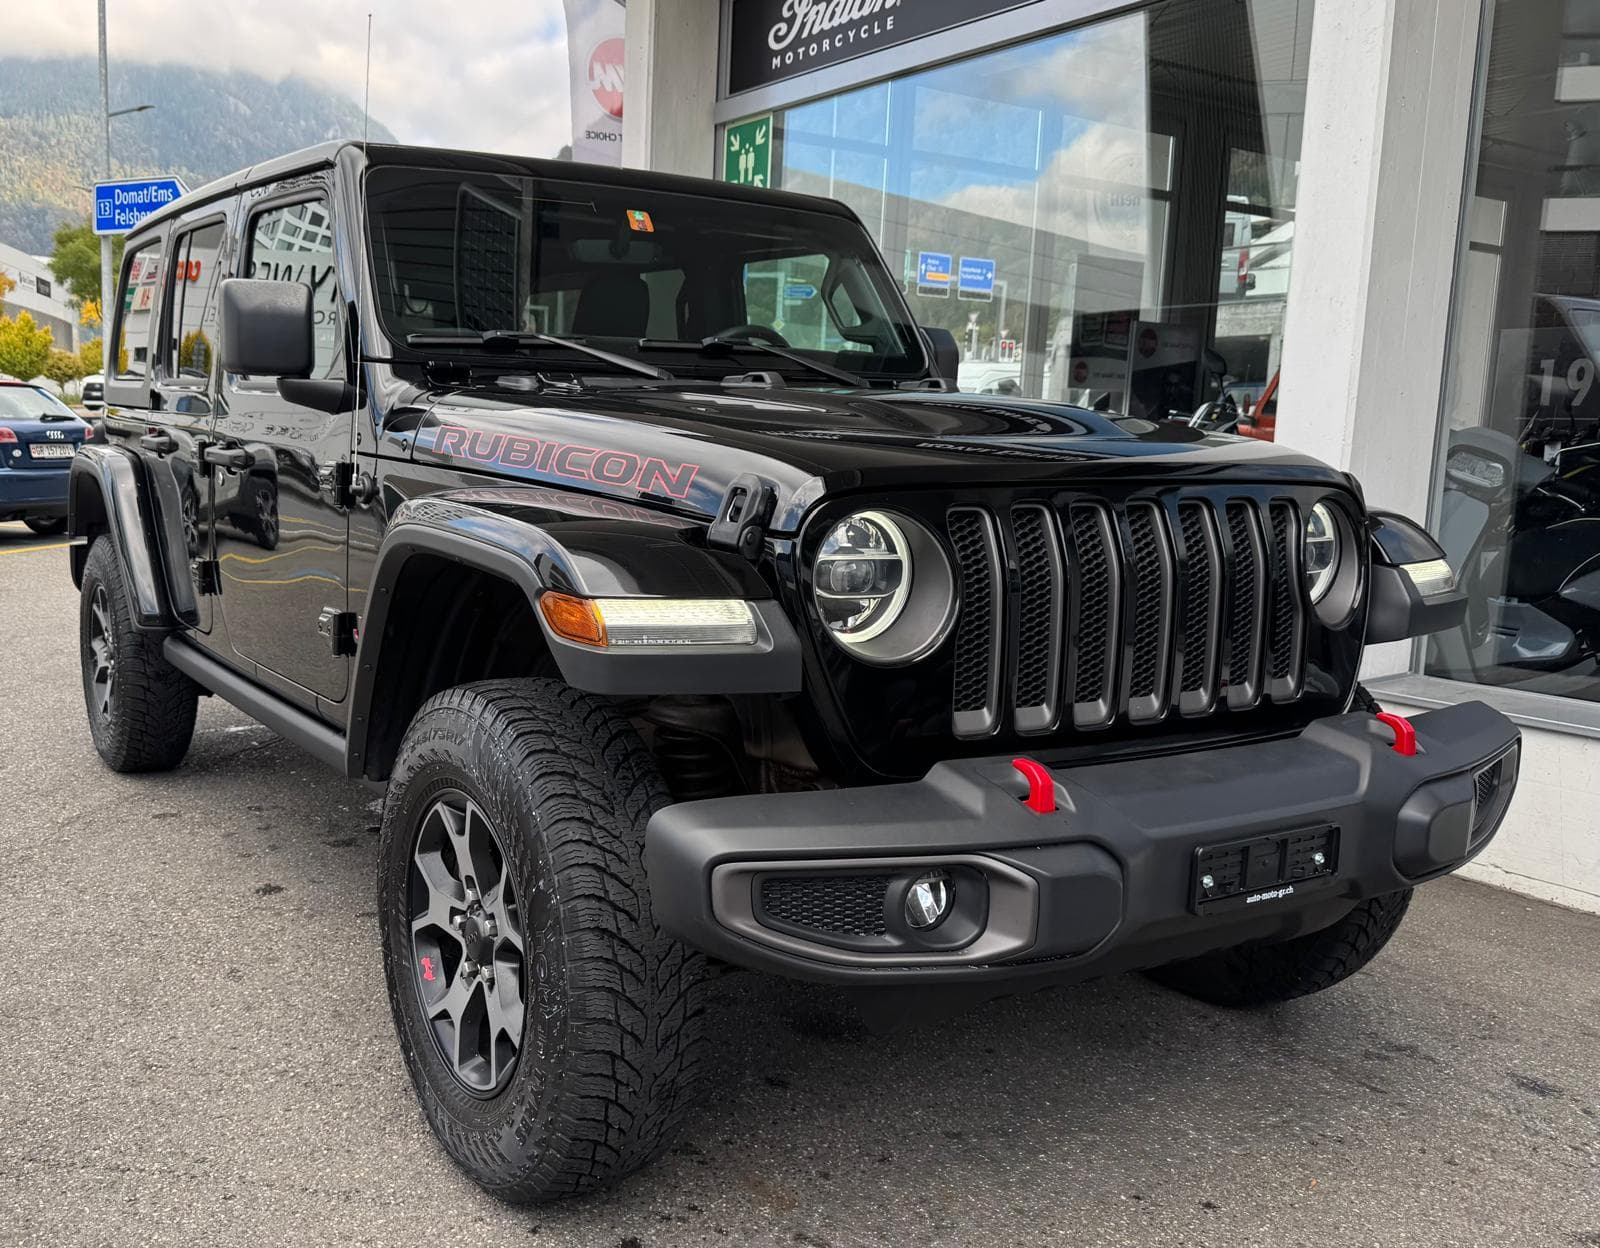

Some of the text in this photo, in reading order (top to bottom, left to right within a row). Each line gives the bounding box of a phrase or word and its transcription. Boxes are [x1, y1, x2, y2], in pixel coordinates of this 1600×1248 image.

[772, 16, 895, 70] MOTORCYCLE
[100, 201, 111, 216] 13
[114, 185, 174, 206] Domat/Ems
[1540, 358, 1595, 407] 19
[432, 424, 700, 500] RUBICON
[1246, 885, 1294, 903] auto-moto-gr.ch
